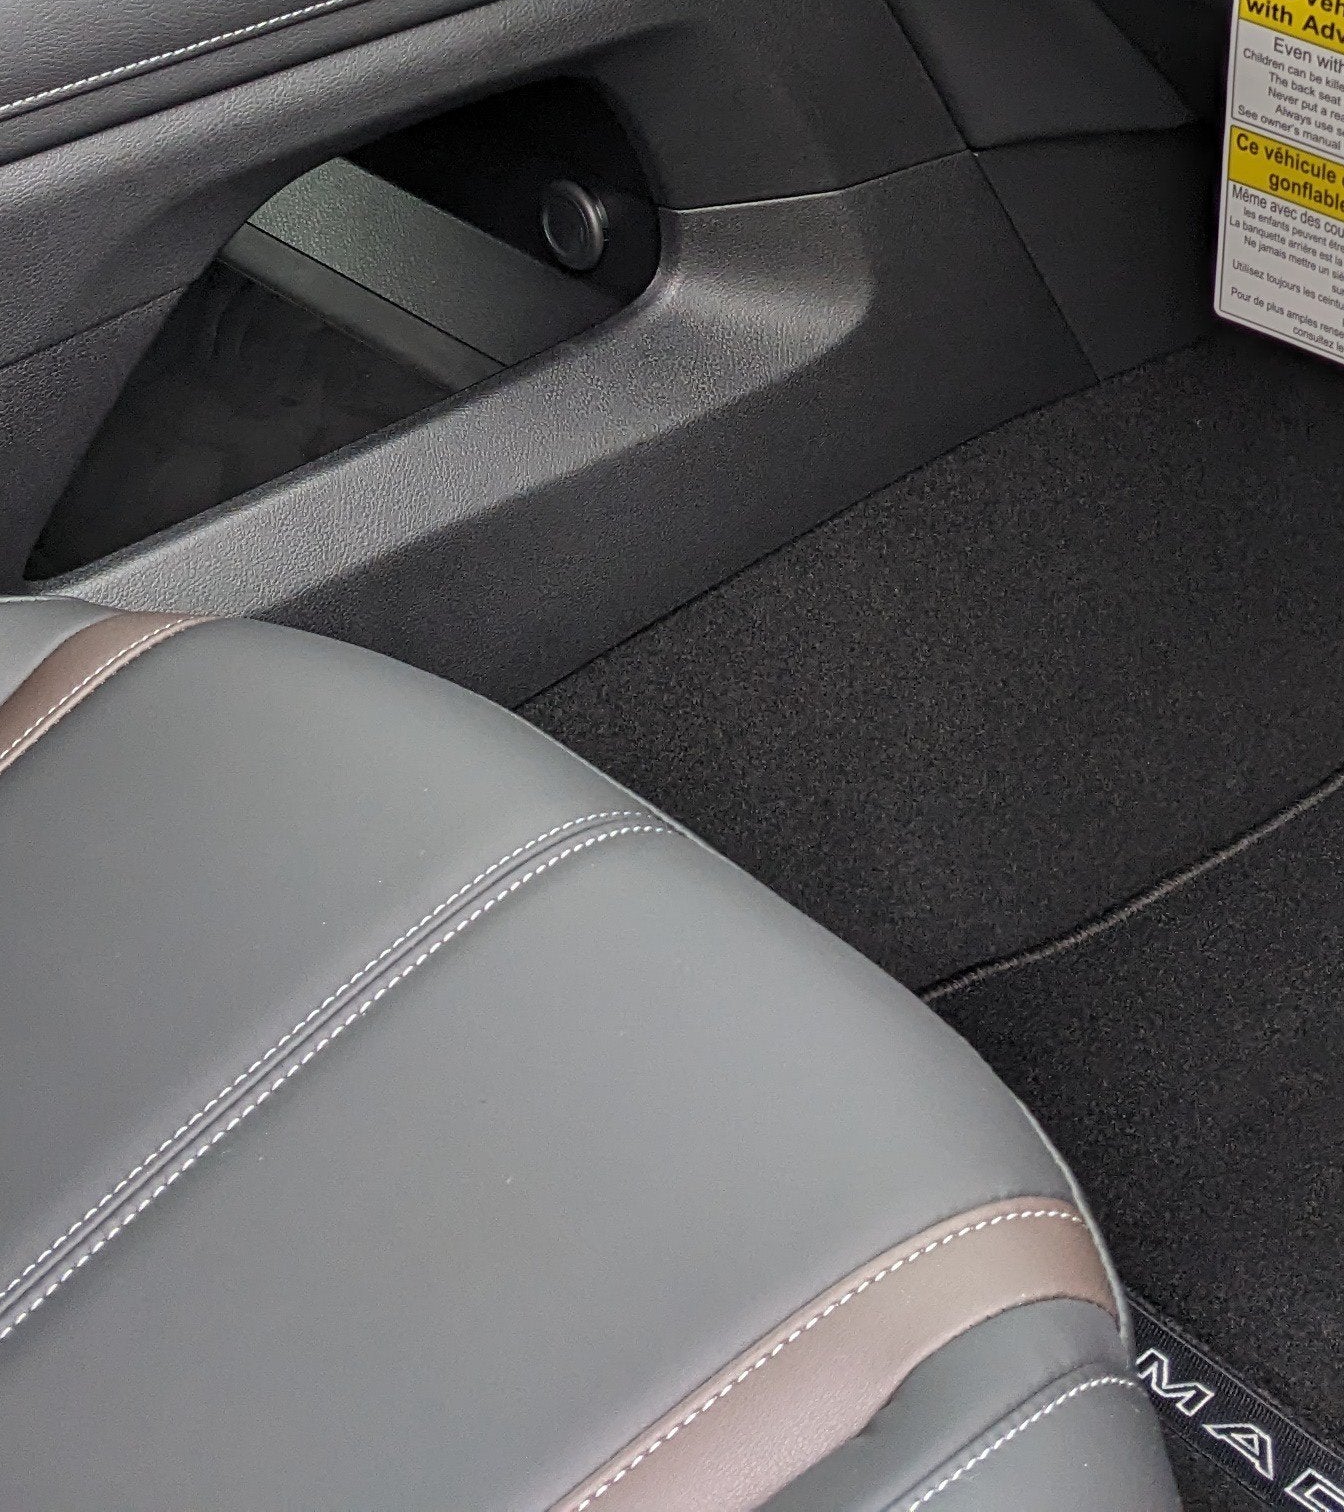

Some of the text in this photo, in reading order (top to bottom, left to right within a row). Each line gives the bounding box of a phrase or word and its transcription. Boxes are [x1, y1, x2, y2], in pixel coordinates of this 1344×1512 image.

[1243, 48, 1285, 72] Children
[1287, 66, 1306, 79] can
[1309, 71, 1323, 85] be
[1273, 36, 1312, 64] Even
[1268, 86, 1299, 105] Never
[1301, 100, 1318, 113] put
[1320, 107, 1327, 116] a
[1269, 71, 1288, 88] The
[1291, 80, 1315, 97] back
[1318, 91, 1341, 107] seat
[1238, 104, 1258, 121] See
[1260, 115, 1300, 136] owner's
[1302, 130, 1341, 151] manual
[1275, 104, 1312, 127] Always
[1314, 120, 1334, 133] use
[1236, 133, 1259, 155] Ce
[1264, 145, 1336, 184] véhicule
[1232, 184, 1267, 209] Même
[1270, 201, 1298, 221] avec
[1300, 210, 1321, 230] des
[1243, 206, 1256, 220] les
[1258, 214, 1290, 233] enfants
[1291, 226, 1327, 247] peuvent
[1229, 215, 1241, 228] La
[1242, 220, 1286, 245] banquette
[1319, 251, 1333, 264] est
[1334, 255, 1343, 267] la
[1244, 235, 1257, 248] Ne
[1258, 241, 1287, 260] jamais
[1288, 254, 1317, 271] mettre
[1318, 265, 1330, 276] un
[1266, 272, 1301, 295] toujours
[1303, 286, 1316, 300] les
[1231, 286, 1251, 302] Pour
[1253, 296, 1265, 308] de
[1266, 302, 1285, 315] plus
[1286, 310, 1318, 329] amples
[1292, 326, 1334, 349] consultez
[1336, 341, 1344, 353] le
